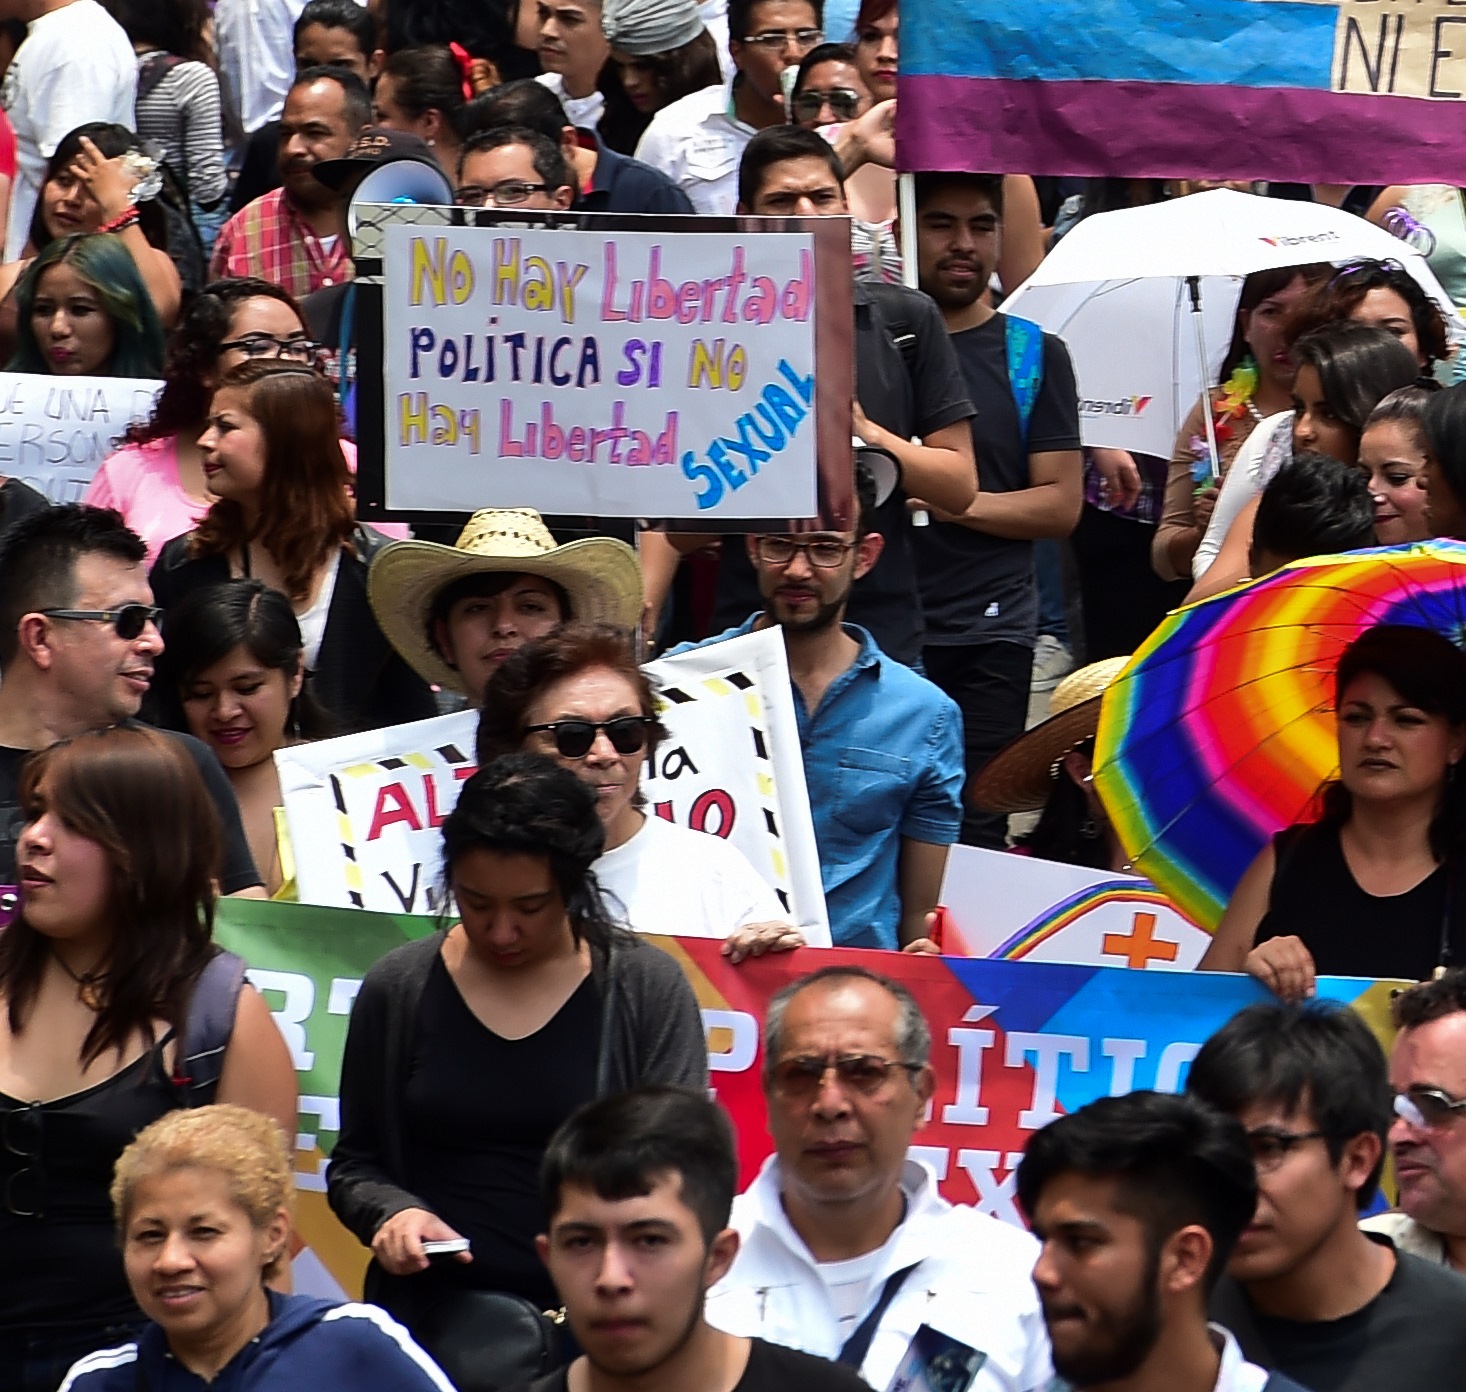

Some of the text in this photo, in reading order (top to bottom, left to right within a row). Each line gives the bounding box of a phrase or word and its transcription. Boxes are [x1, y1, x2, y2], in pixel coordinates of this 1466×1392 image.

[1341, 12, 1402, 94] NI
[600, 240, 815, 326] Libertad
[616, 338, 663, 390] SI
[44, 387, 110, 424] UNA
[497, 396, 680, 467] Libertad
[680, 358, 816, 510] SEXUAL
